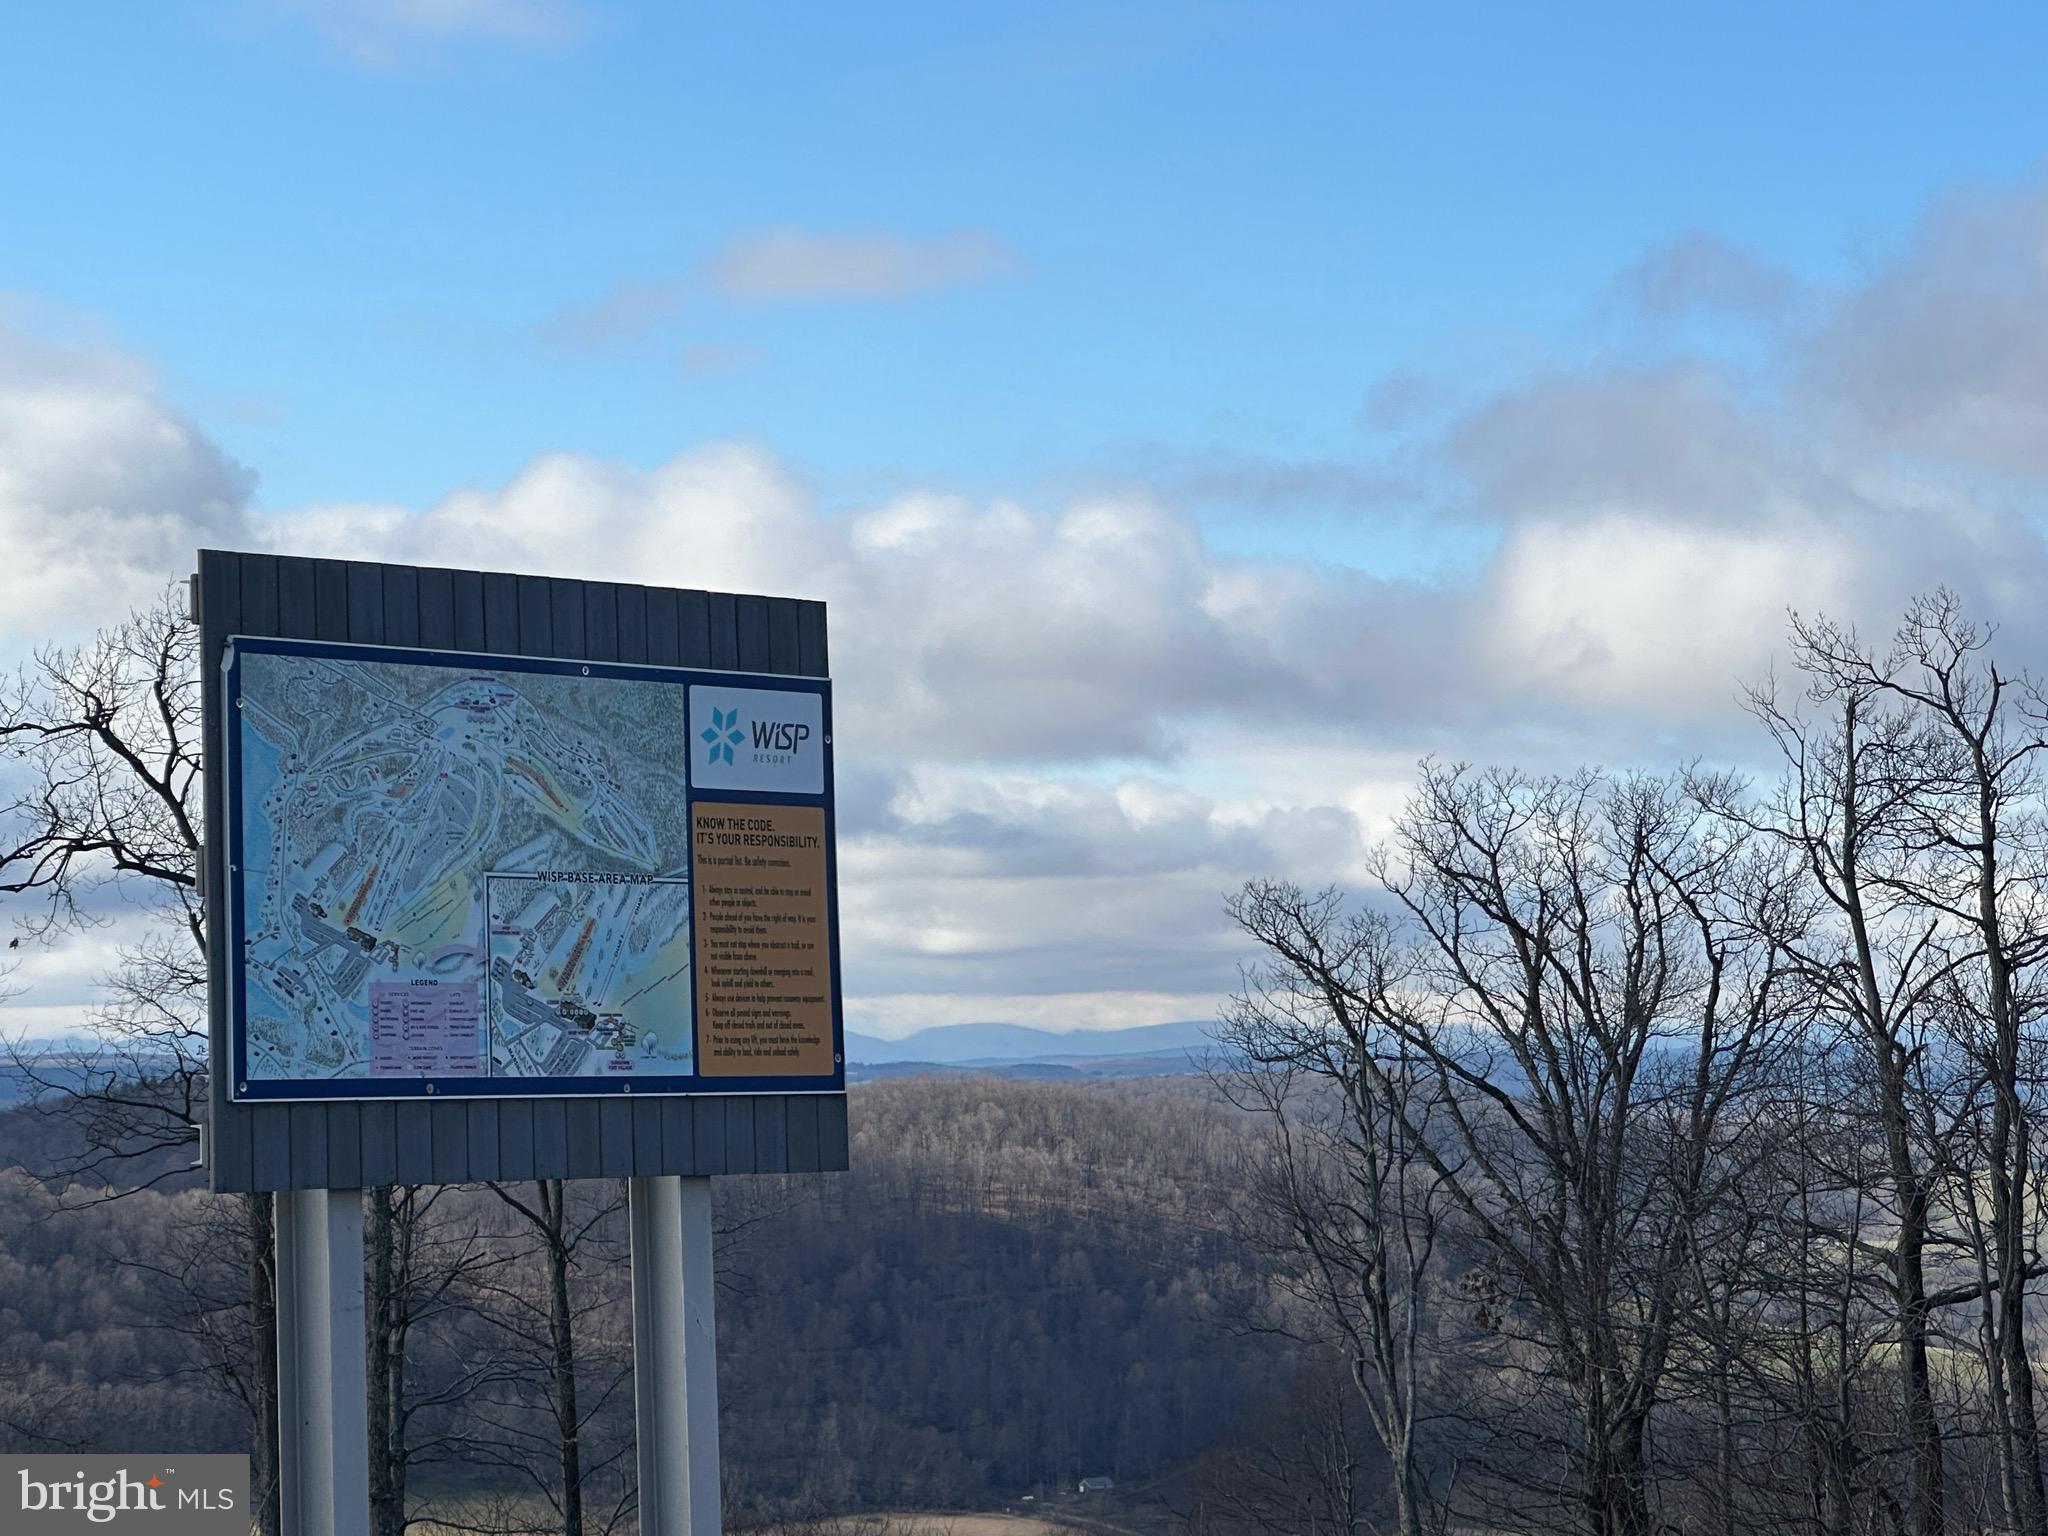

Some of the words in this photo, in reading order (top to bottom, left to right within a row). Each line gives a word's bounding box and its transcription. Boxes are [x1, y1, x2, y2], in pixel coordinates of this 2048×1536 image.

[754, 754, 792, 764] RESORT
[696, 817, 725, 830] KNOW
[728, 818, 745, 830] THE
[748, 819, 775, 832] CODE.
[696, 832, 714, 844] IT'S
[716, 833, 741, 846] YOUR
[744, 834, 820, 848] RESPONSIBILITY.
[537, 871, 563, 883] WISP
[568, 872, 594, 884] BASE
[599, 874, 626, 884] AREA
[631, 874, 653, 885] MAP
